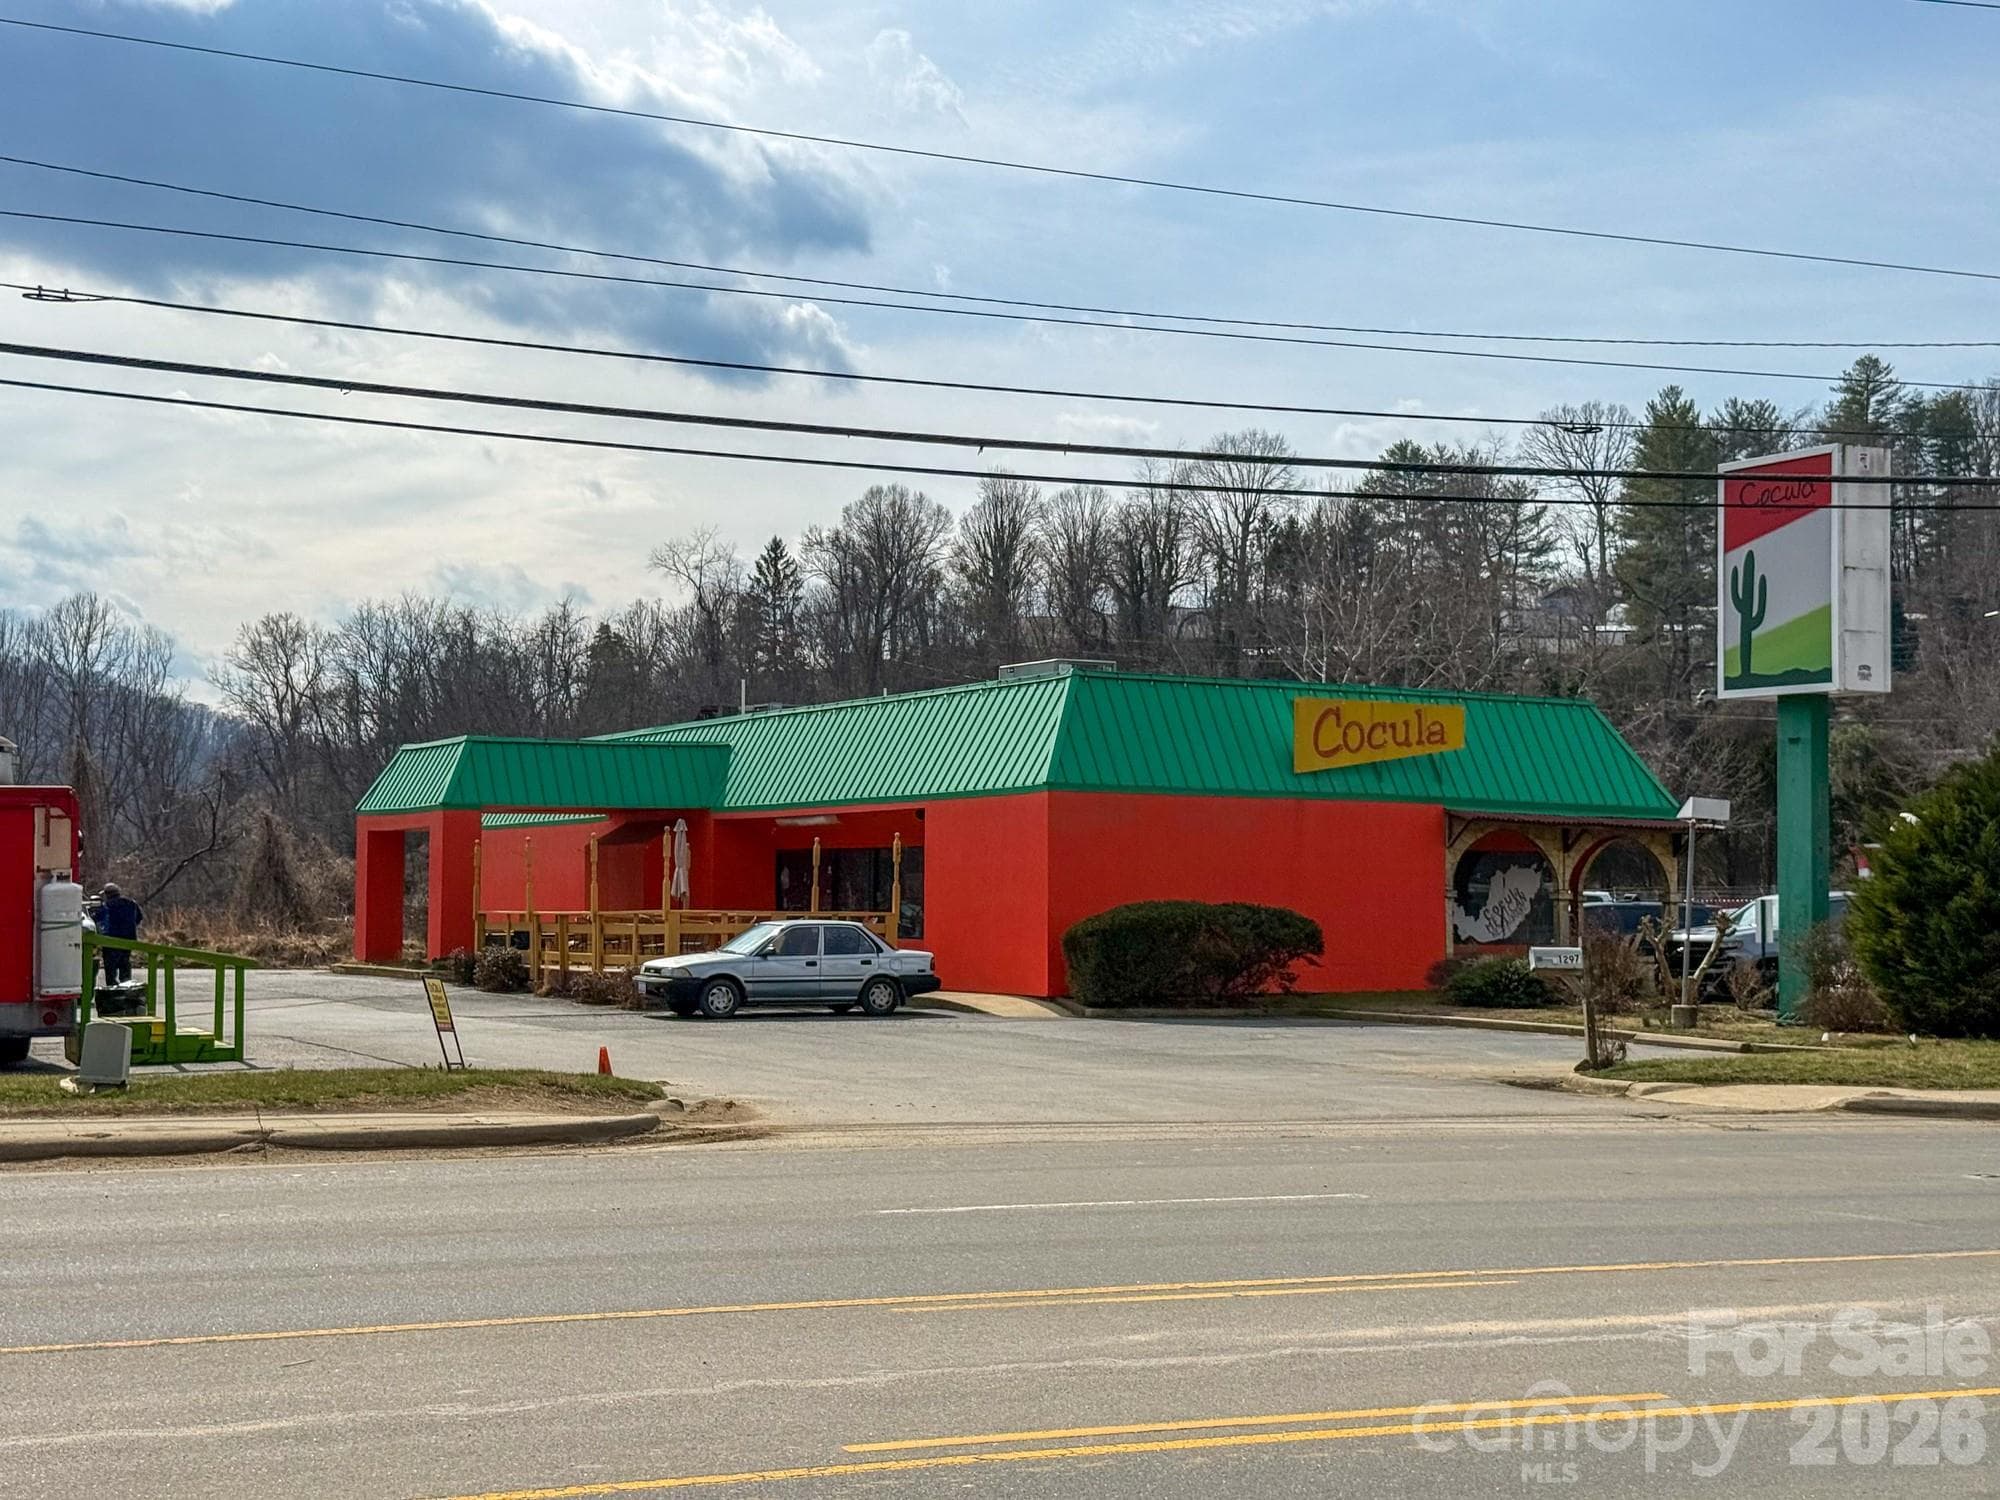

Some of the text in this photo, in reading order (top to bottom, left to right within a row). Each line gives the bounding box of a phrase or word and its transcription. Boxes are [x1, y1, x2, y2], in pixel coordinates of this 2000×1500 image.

[1739, 481, 1816, 506] Cocula
[1312, 706, 1447, 758] Cocula
[1558, 954, 1579, 964] 1297
